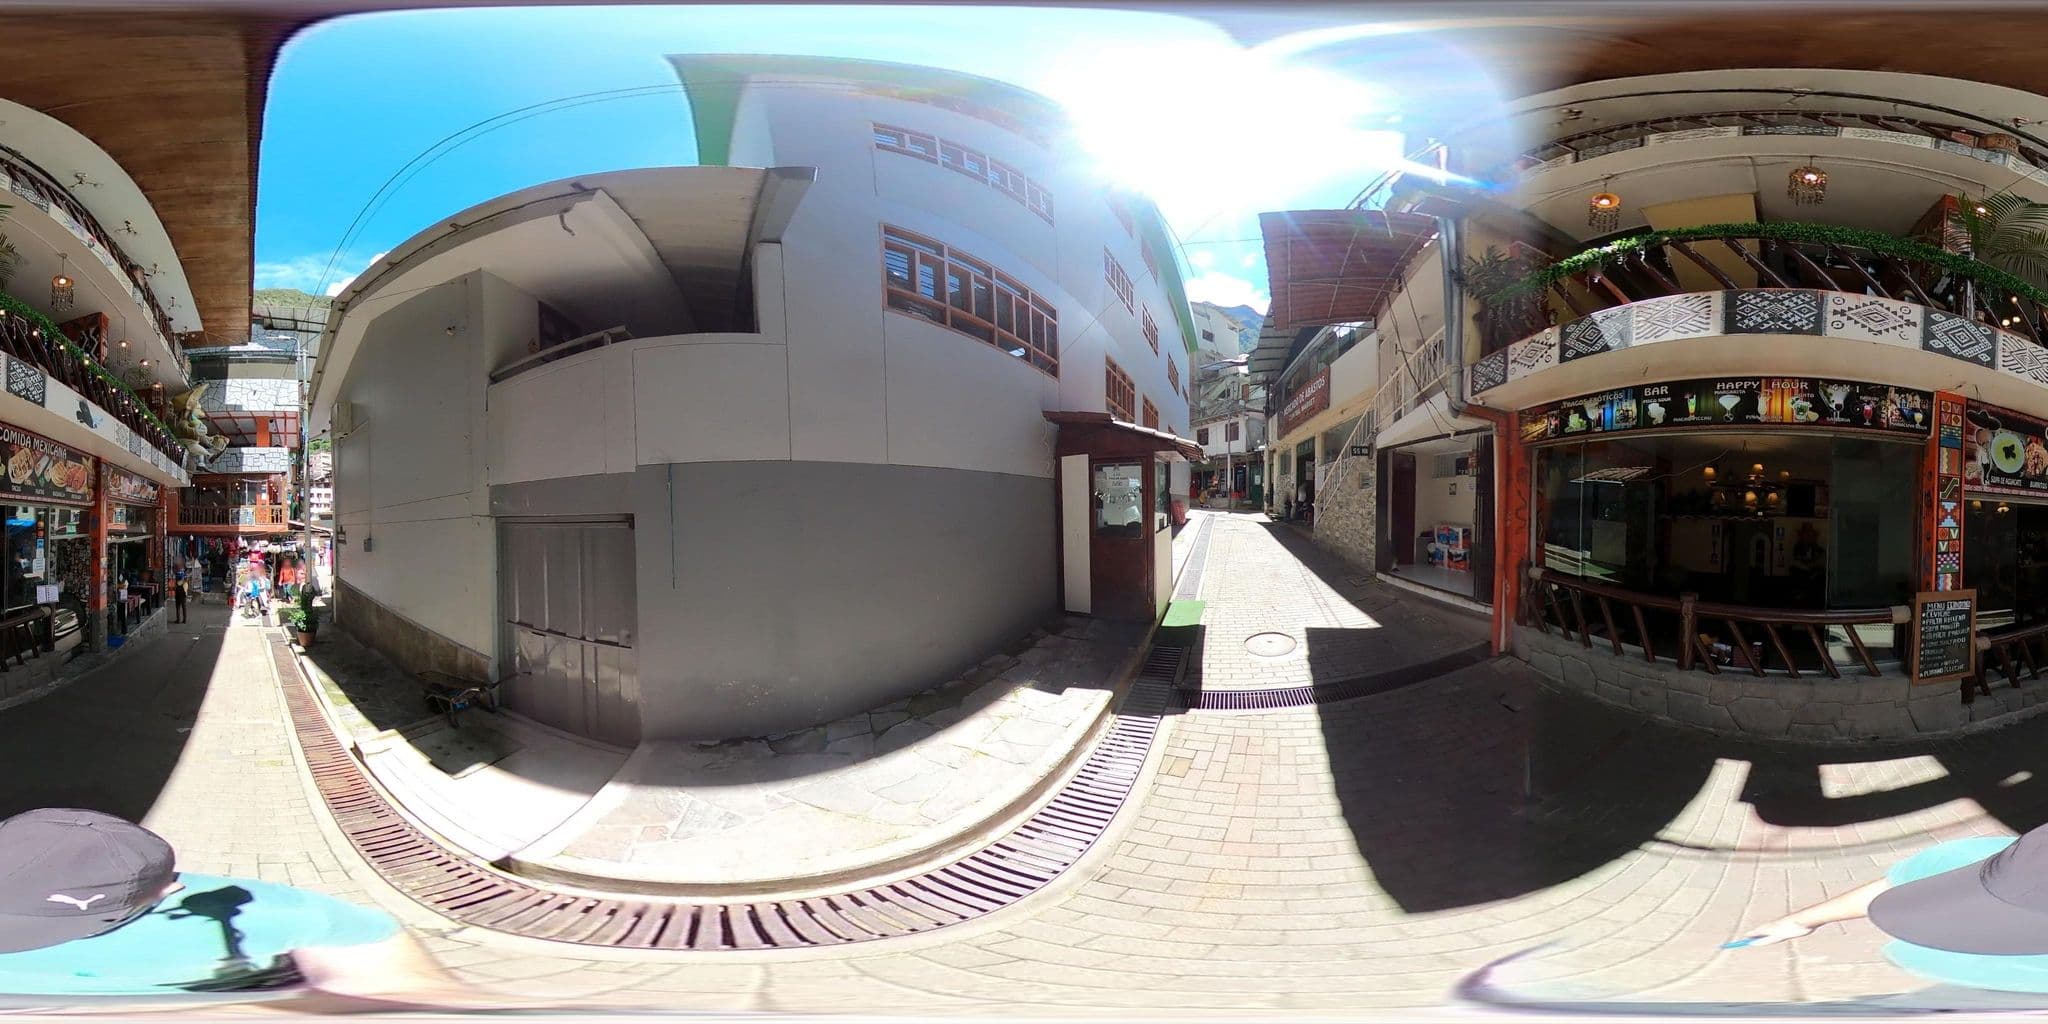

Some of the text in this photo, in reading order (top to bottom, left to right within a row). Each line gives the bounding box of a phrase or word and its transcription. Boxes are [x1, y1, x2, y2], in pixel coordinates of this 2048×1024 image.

[1643, 385, 1669, 397] BAR
[1716, 381, 1809, 390] HAPPY HOUR
[33, 438, 67, 459] MEXICANA
